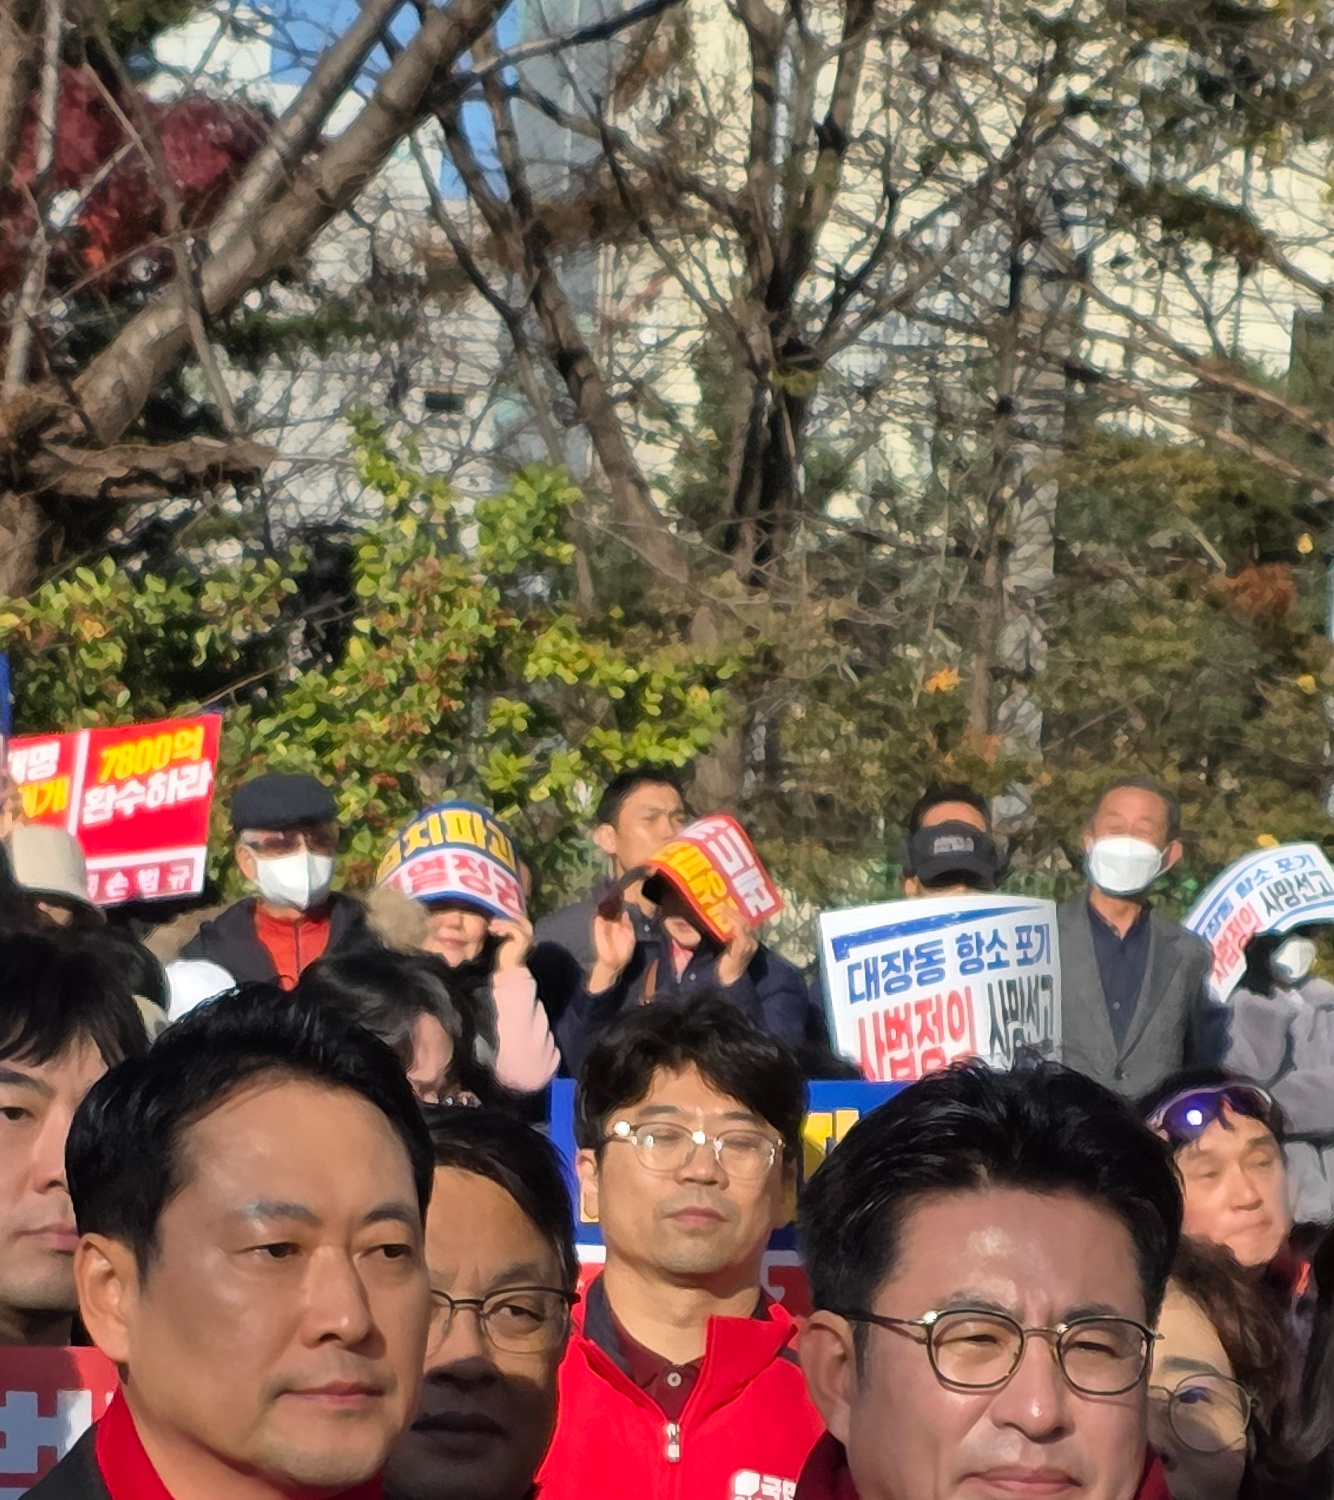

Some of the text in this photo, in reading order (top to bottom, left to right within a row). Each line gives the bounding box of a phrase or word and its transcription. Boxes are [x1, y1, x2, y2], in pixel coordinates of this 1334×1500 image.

[98, 726, 204, 784] 7800억
[82, 761, 212, 826] 환수하라
[847, 923, 1051, 1004] 대장동 항소 포기
